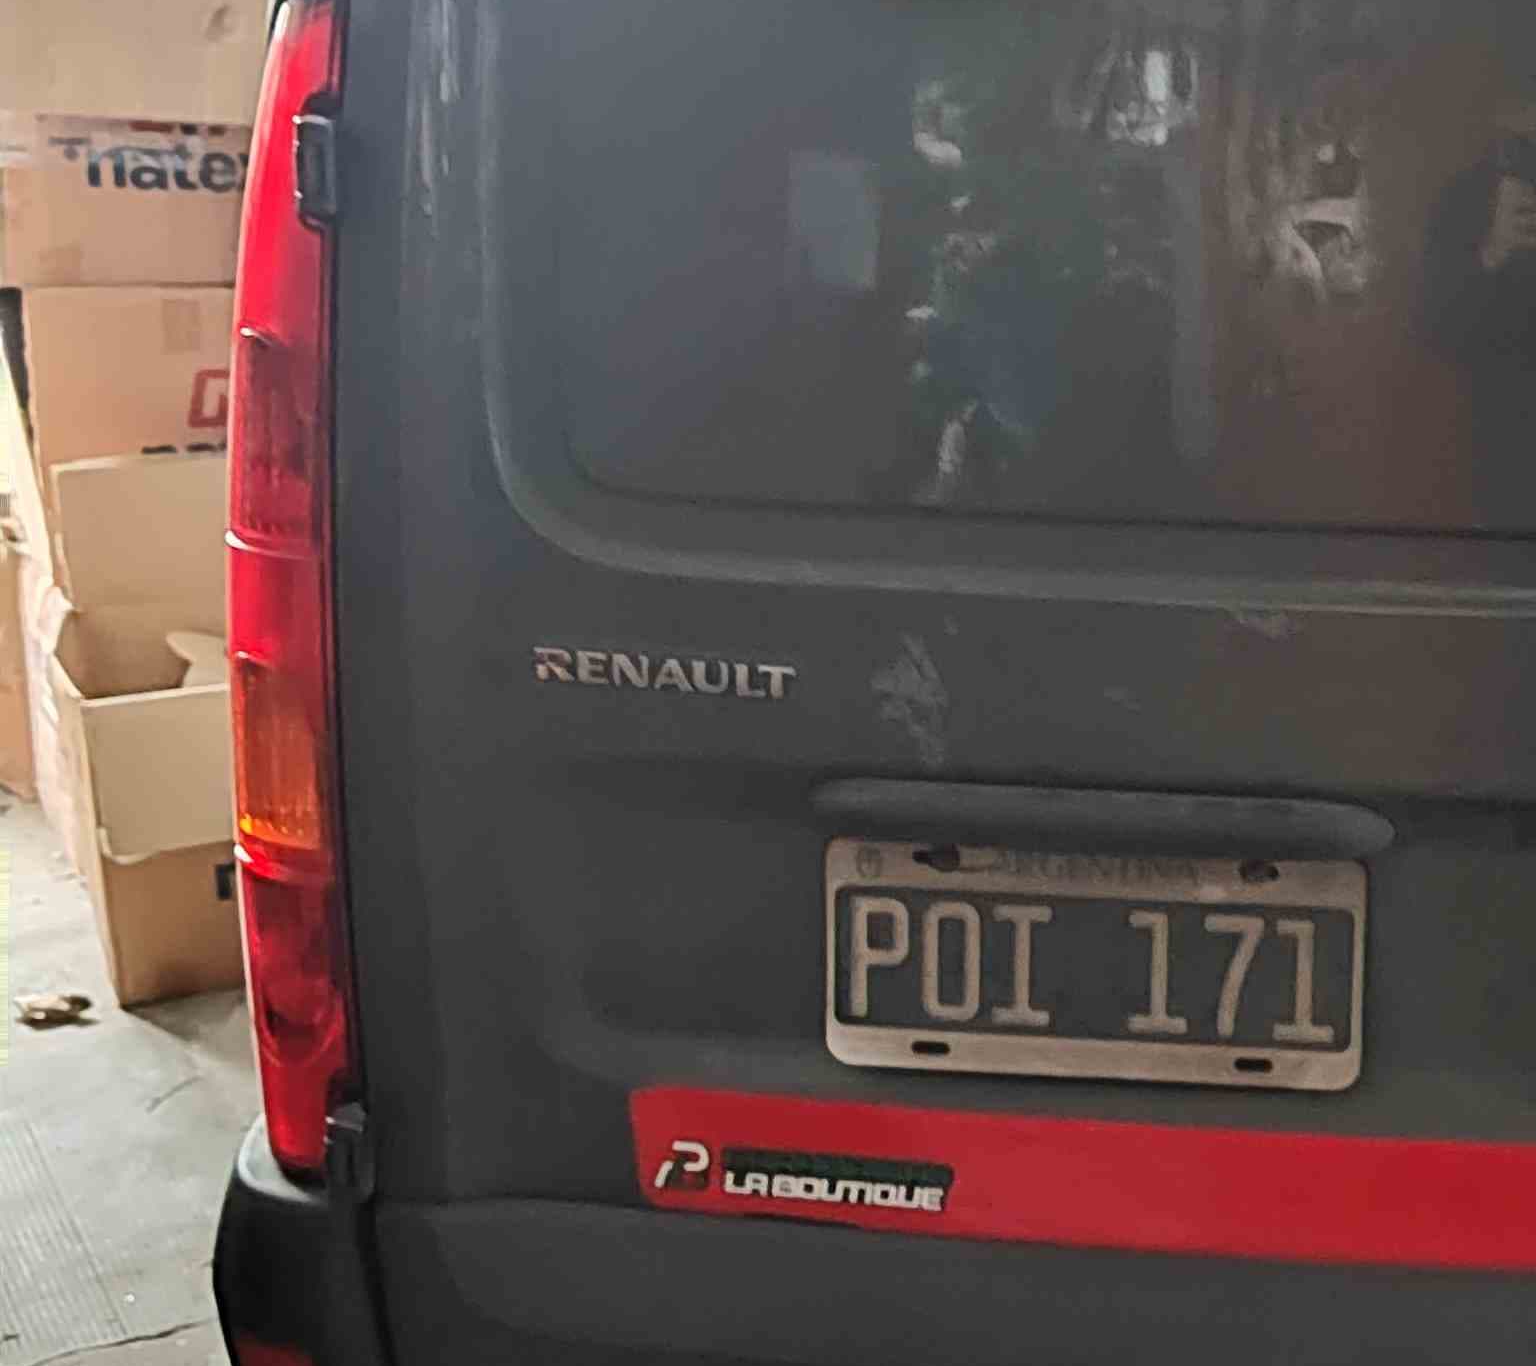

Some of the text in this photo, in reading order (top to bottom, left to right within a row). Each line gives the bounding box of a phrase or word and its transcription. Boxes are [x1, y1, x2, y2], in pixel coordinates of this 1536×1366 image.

[532, 645, 797, 700] RENAULT
[848, 895, 1335, 1044] POI 171
